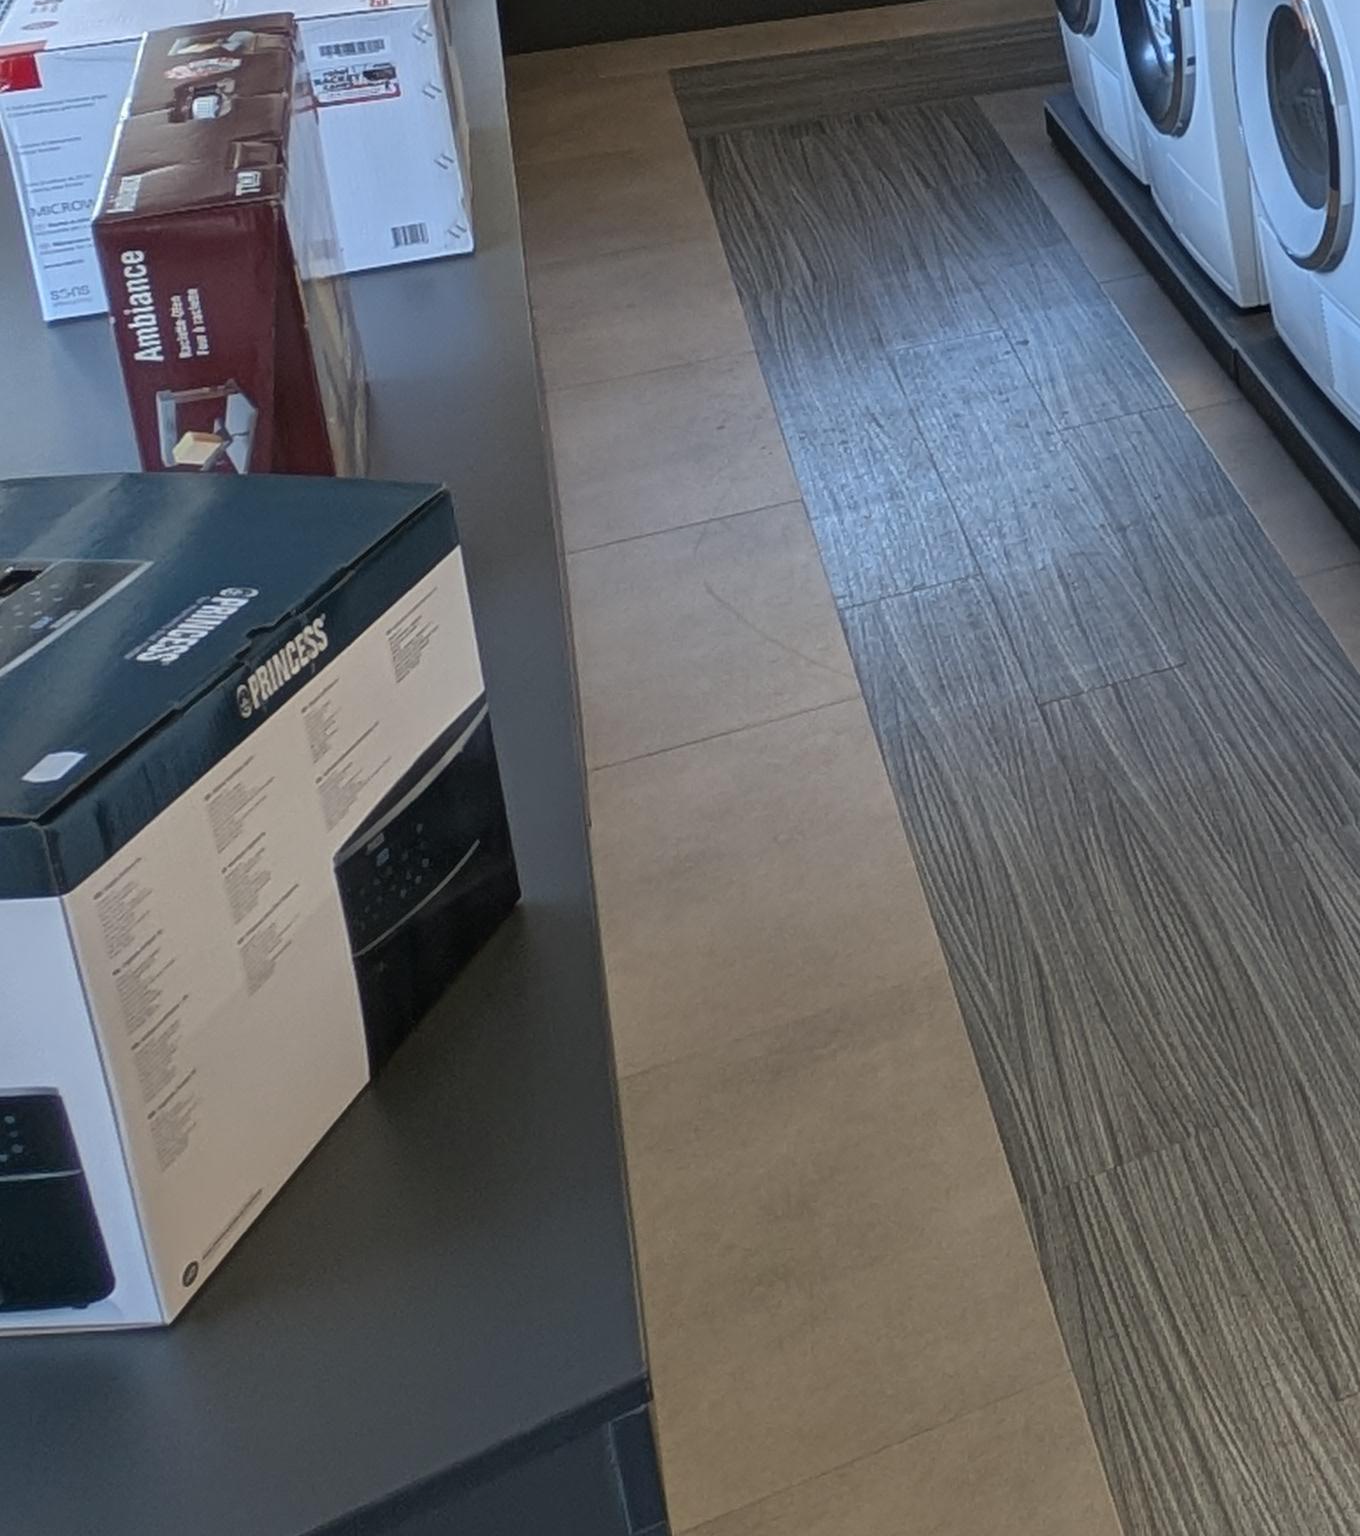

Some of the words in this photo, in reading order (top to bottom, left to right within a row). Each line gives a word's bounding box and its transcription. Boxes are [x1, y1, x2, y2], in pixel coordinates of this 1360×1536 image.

[121, 250, 165, 362] Ambiance
[136, 596, 250, 663] PRINCESS
[247, 616, 329, 710] PRINCESS
